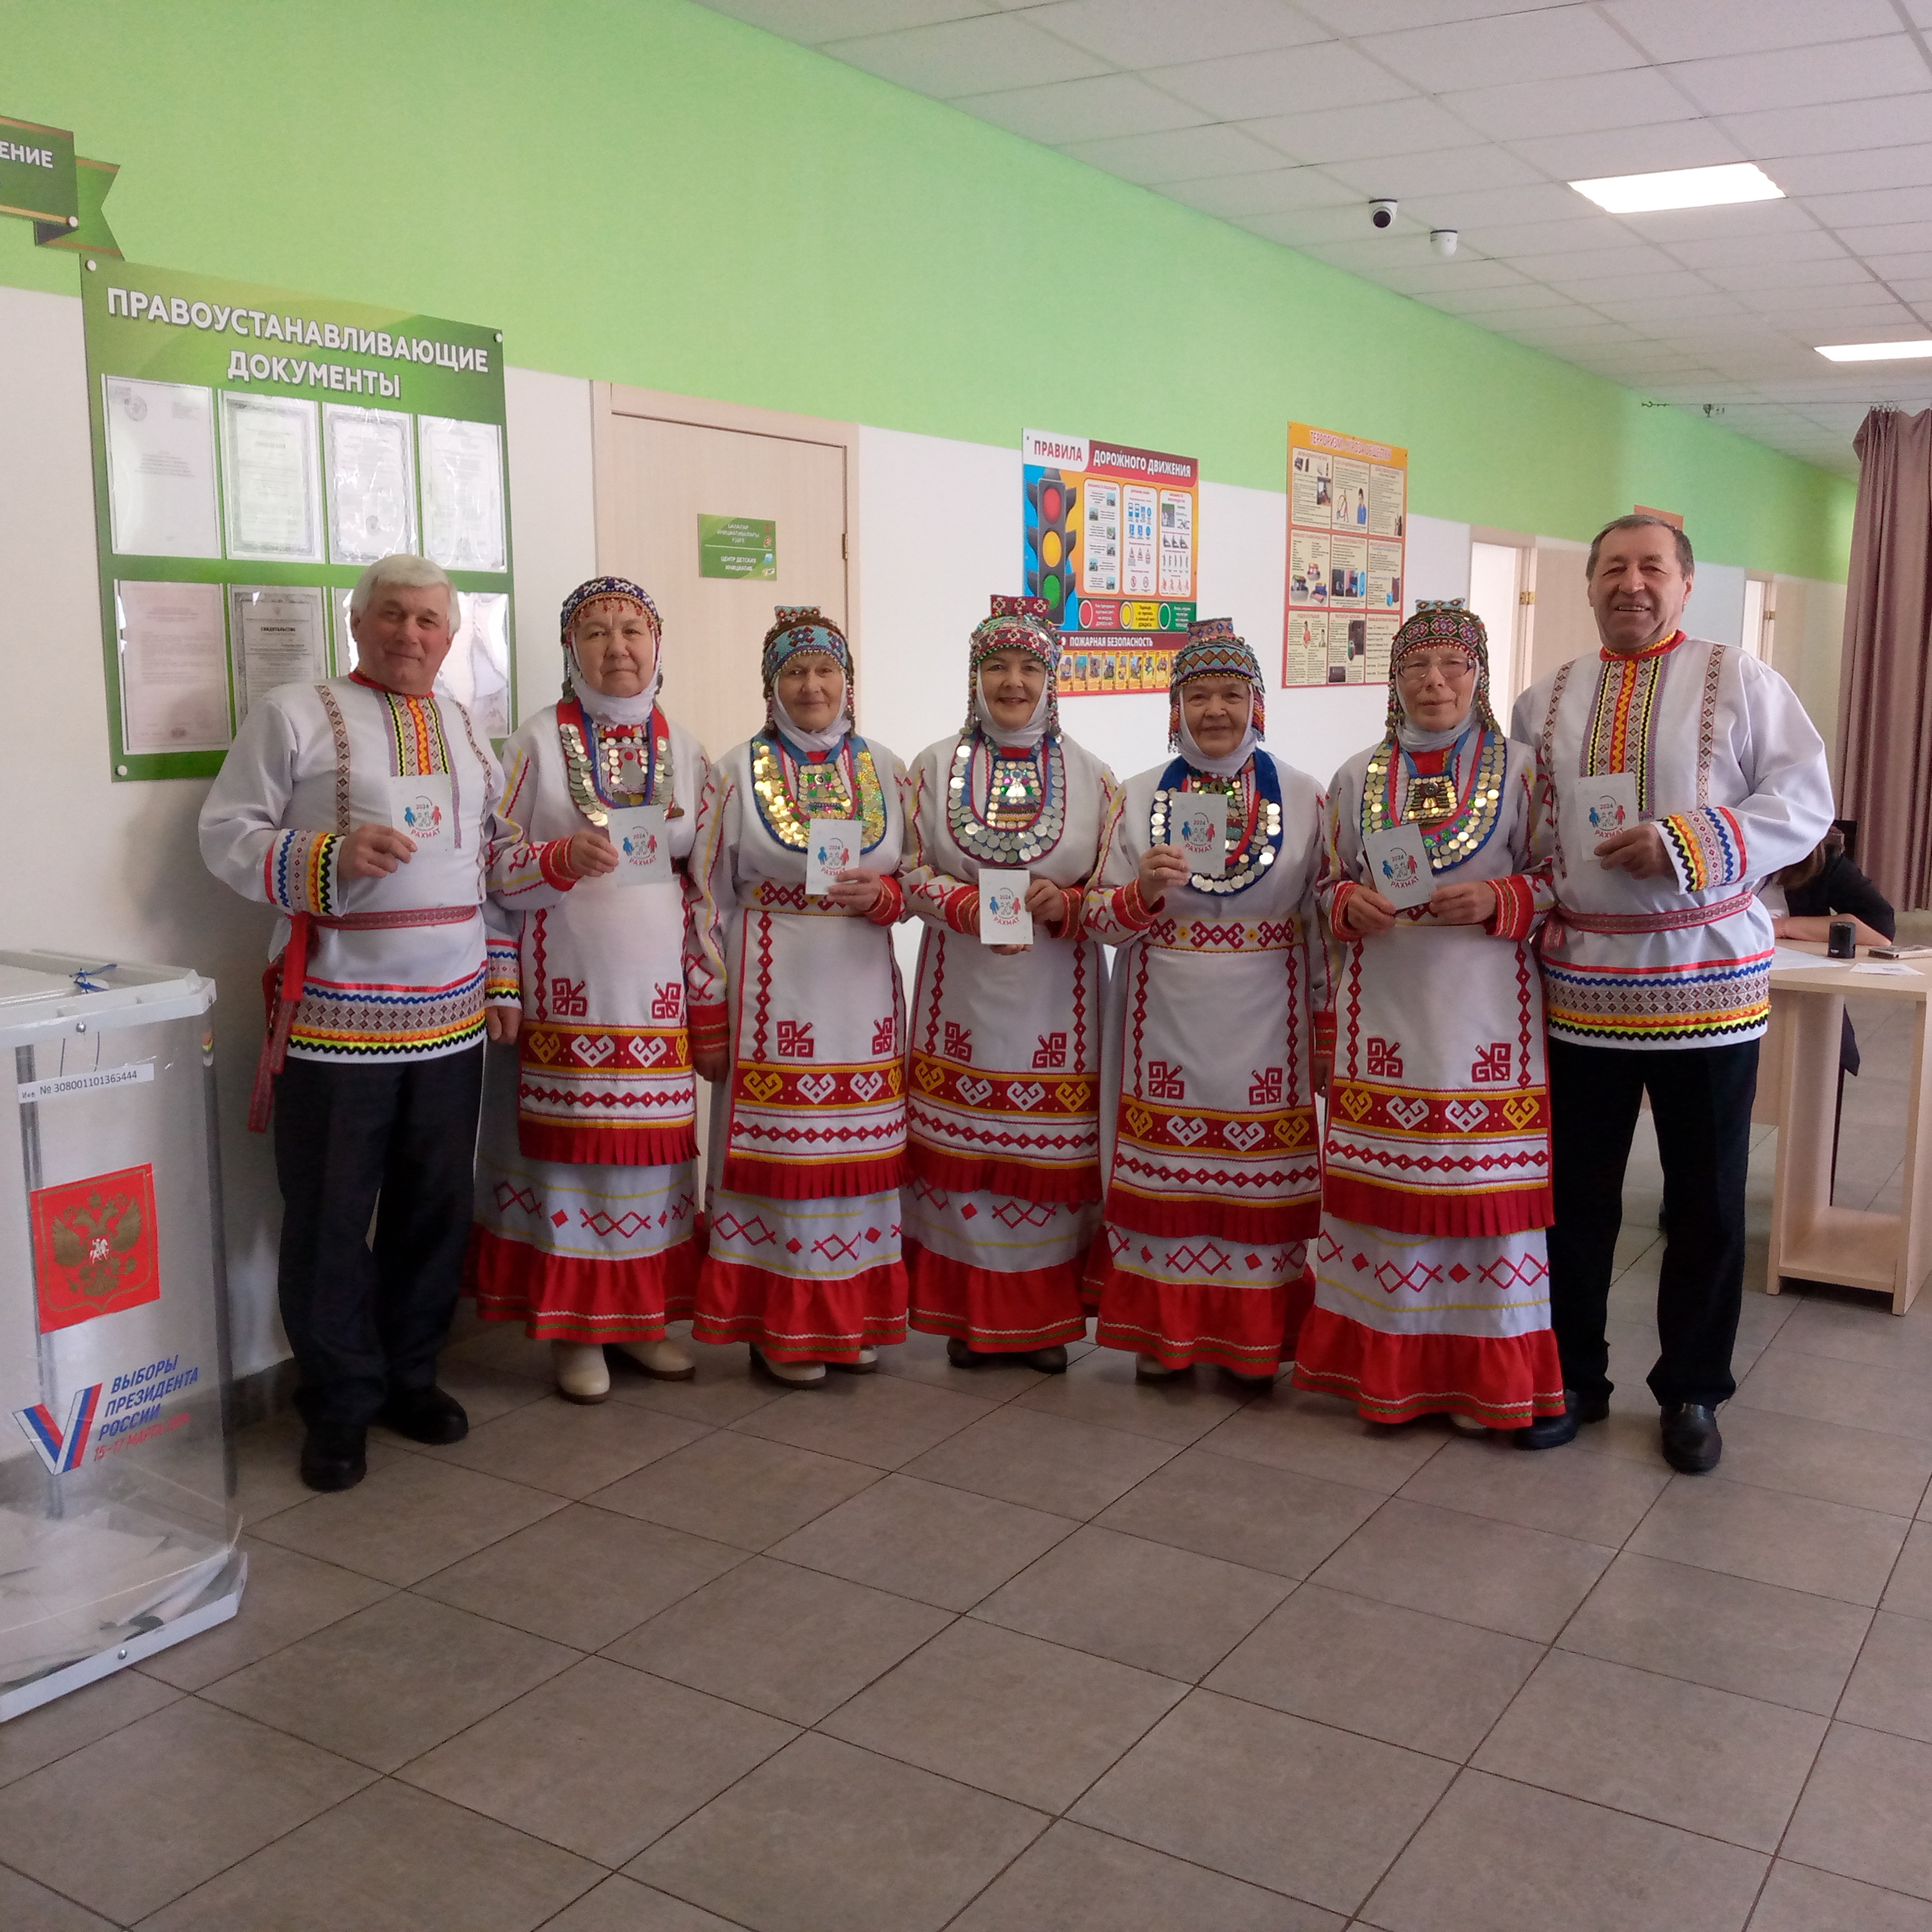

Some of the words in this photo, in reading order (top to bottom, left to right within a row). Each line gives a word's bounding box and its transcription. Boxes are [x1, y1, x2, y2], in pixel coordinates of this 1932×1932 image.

[107, 287, 489, 373] ПРАВОУСТАНАВЛИВАЮЩИЕ
[227, 350, 401, 398] ДОКУМЕНТЫ
[1034, 440, 1082, 462] ПРАВИЛА
[1093, 449, 1146, 471] ДОРОЖНОГО
[1147, 459, 1191, 477] ДВИЖЕНИЯ
[1069, 637, 1107, 647] ПОЖАРНАЯ
[1107, 637, 1153, 647] БЕЗОПАСНОСТЬ
[411, 828, 441, 838] РАХМАТ
[1185, 843, 1212, 853] РАХМАТ
[1390, 876, 1419, 888] РАХМАТ
[993, 916, 1020, 926] РАХМАТ
[40, 1086, 51, 1094] №
[111, 1354, 178, 1394] ВЫБОРЫ
[105, 1367, 198, 1417] ПРЕЗИДЕНТА
[98, 1403, 161, 1441] РОССИИ
